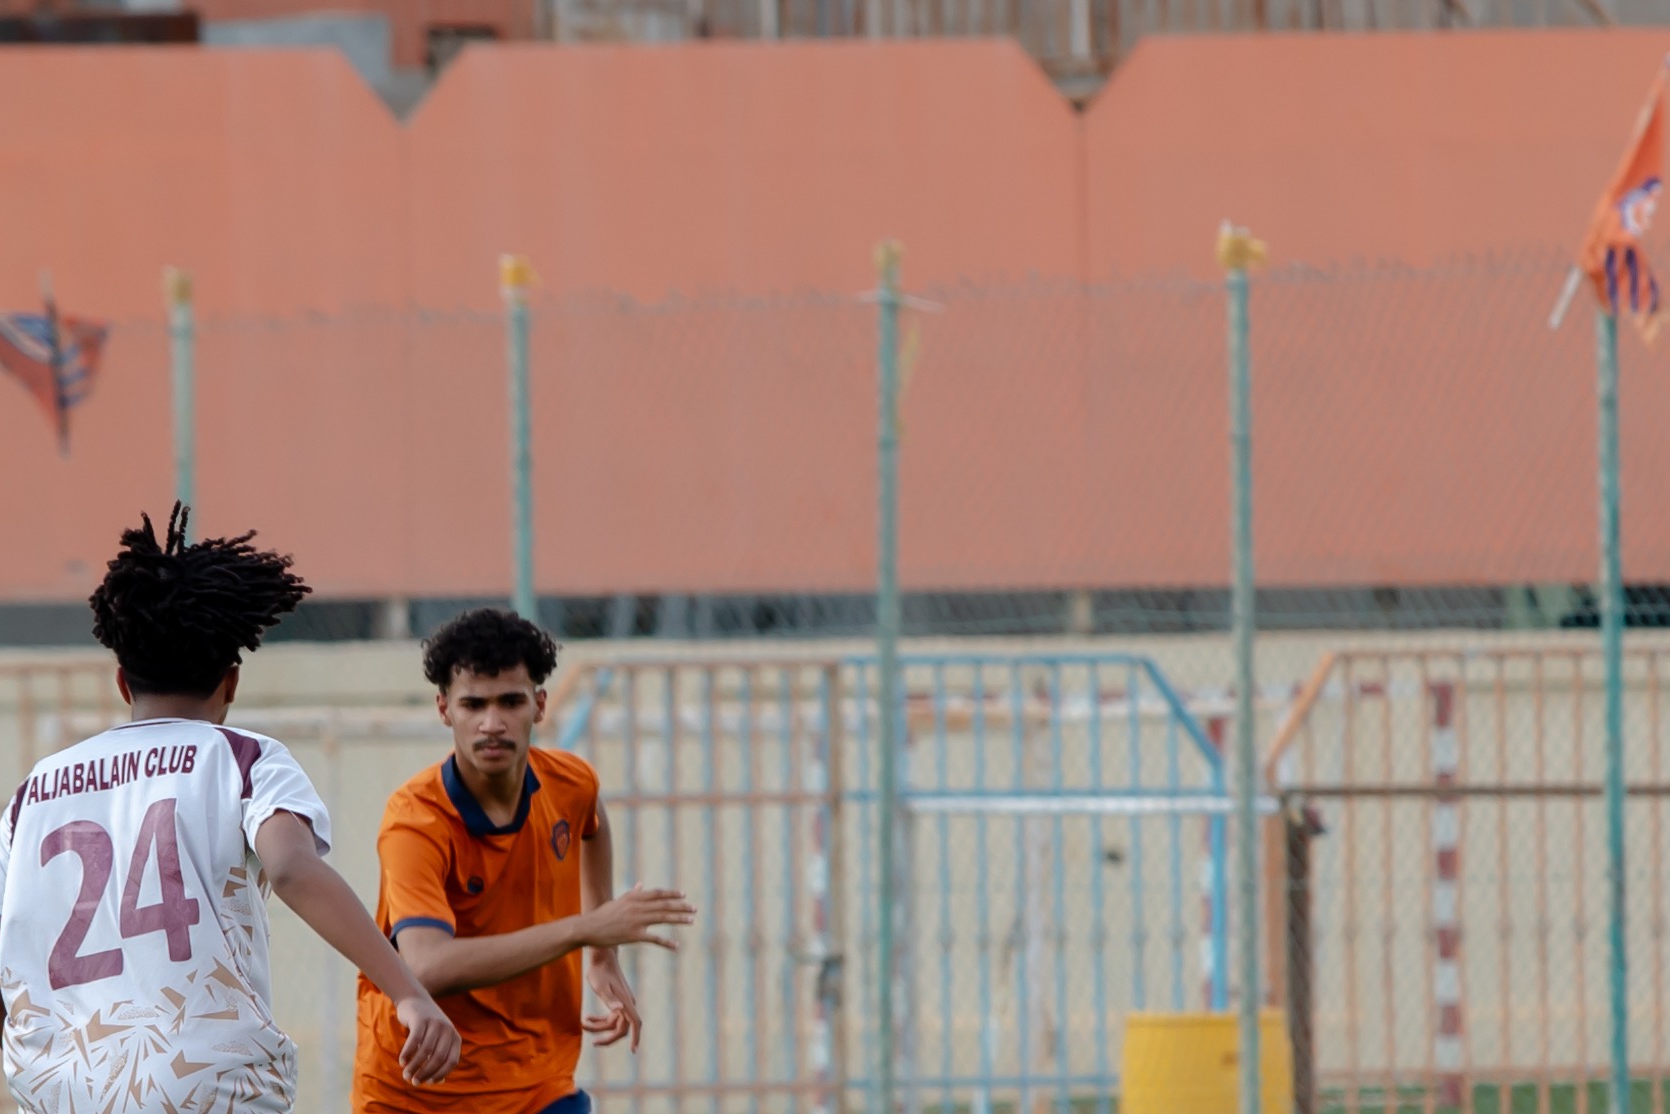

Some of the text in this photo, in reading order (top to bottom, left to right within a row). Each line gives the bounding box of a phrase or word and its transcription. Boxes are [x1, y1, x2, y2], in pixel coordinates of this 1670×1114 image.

[26, 744, 198, 806] ALJABALAIN CLUB
[40, 797, 200, 991] 24
